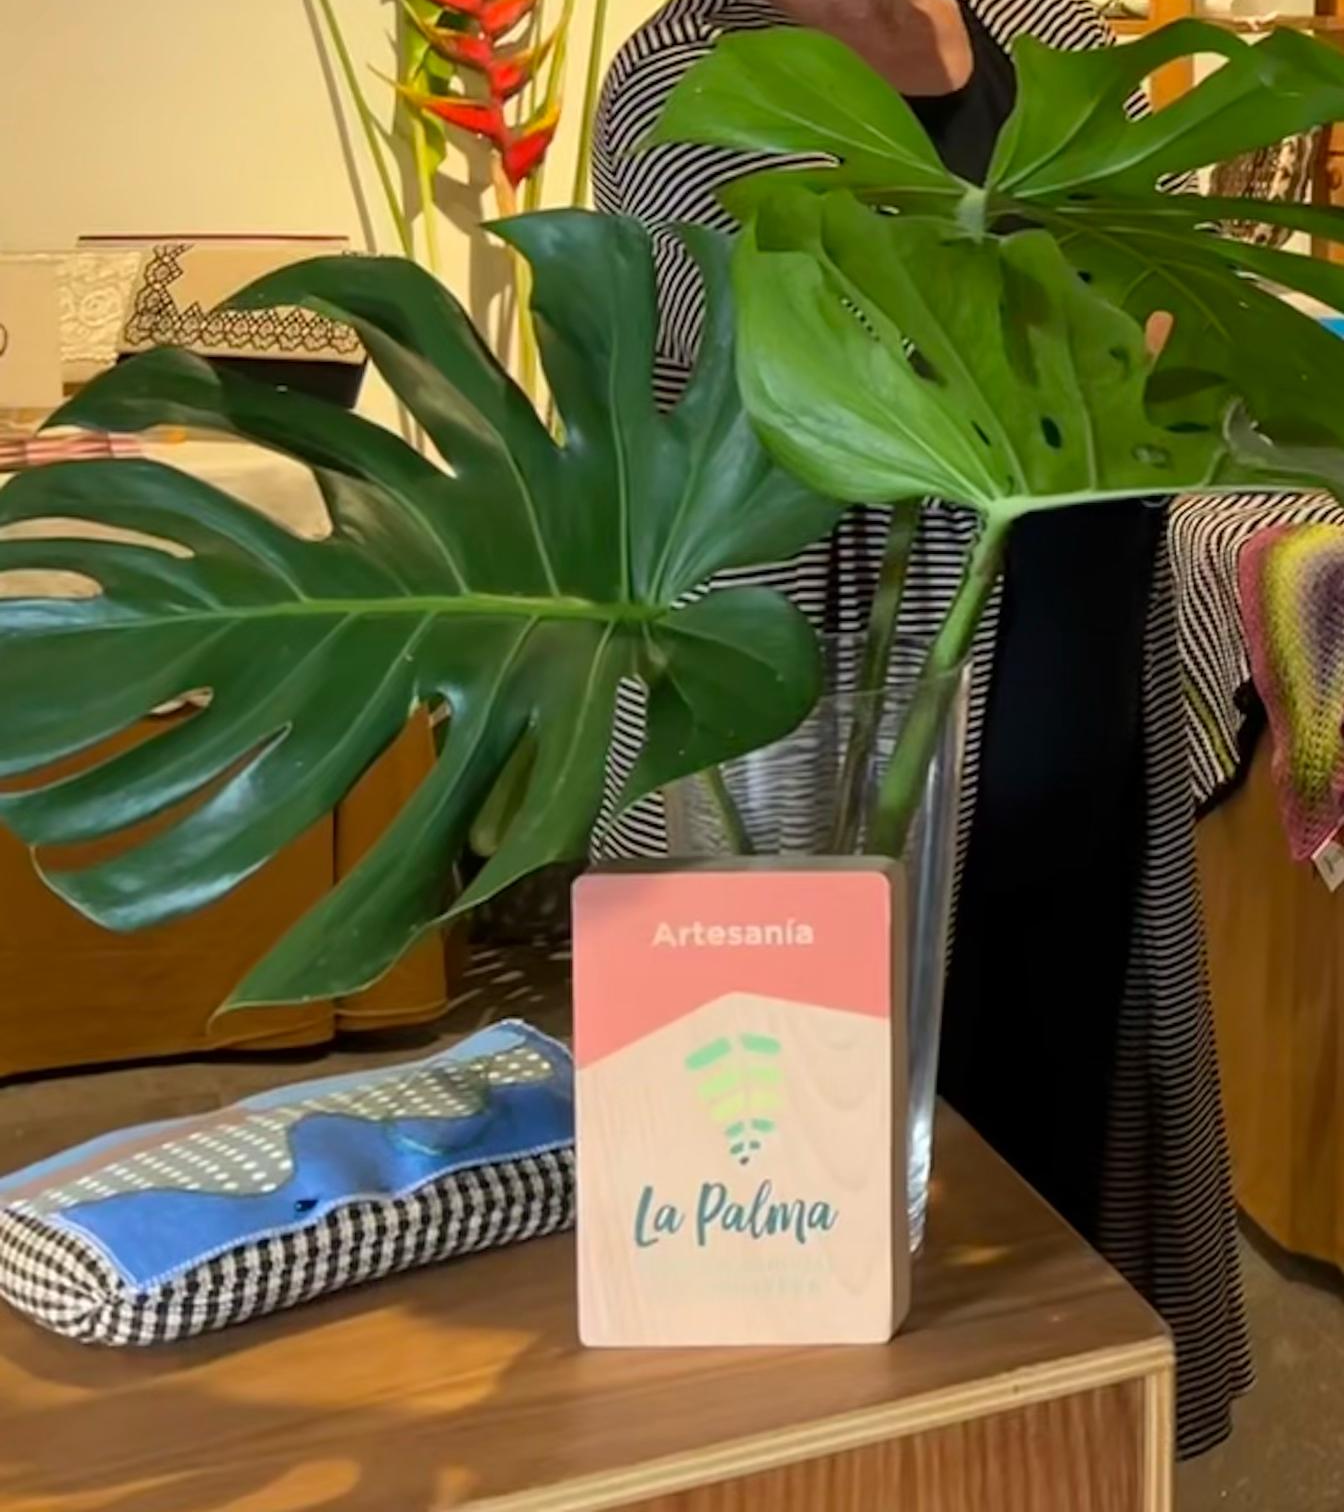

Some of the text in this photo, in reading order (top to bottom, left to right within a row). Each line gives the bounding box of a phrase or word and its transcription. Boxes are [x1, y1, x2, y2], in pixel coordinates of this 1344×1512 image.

[652, 918, 814, 948] Artesanía
[634, 1179, 839, 1248] La Palma
